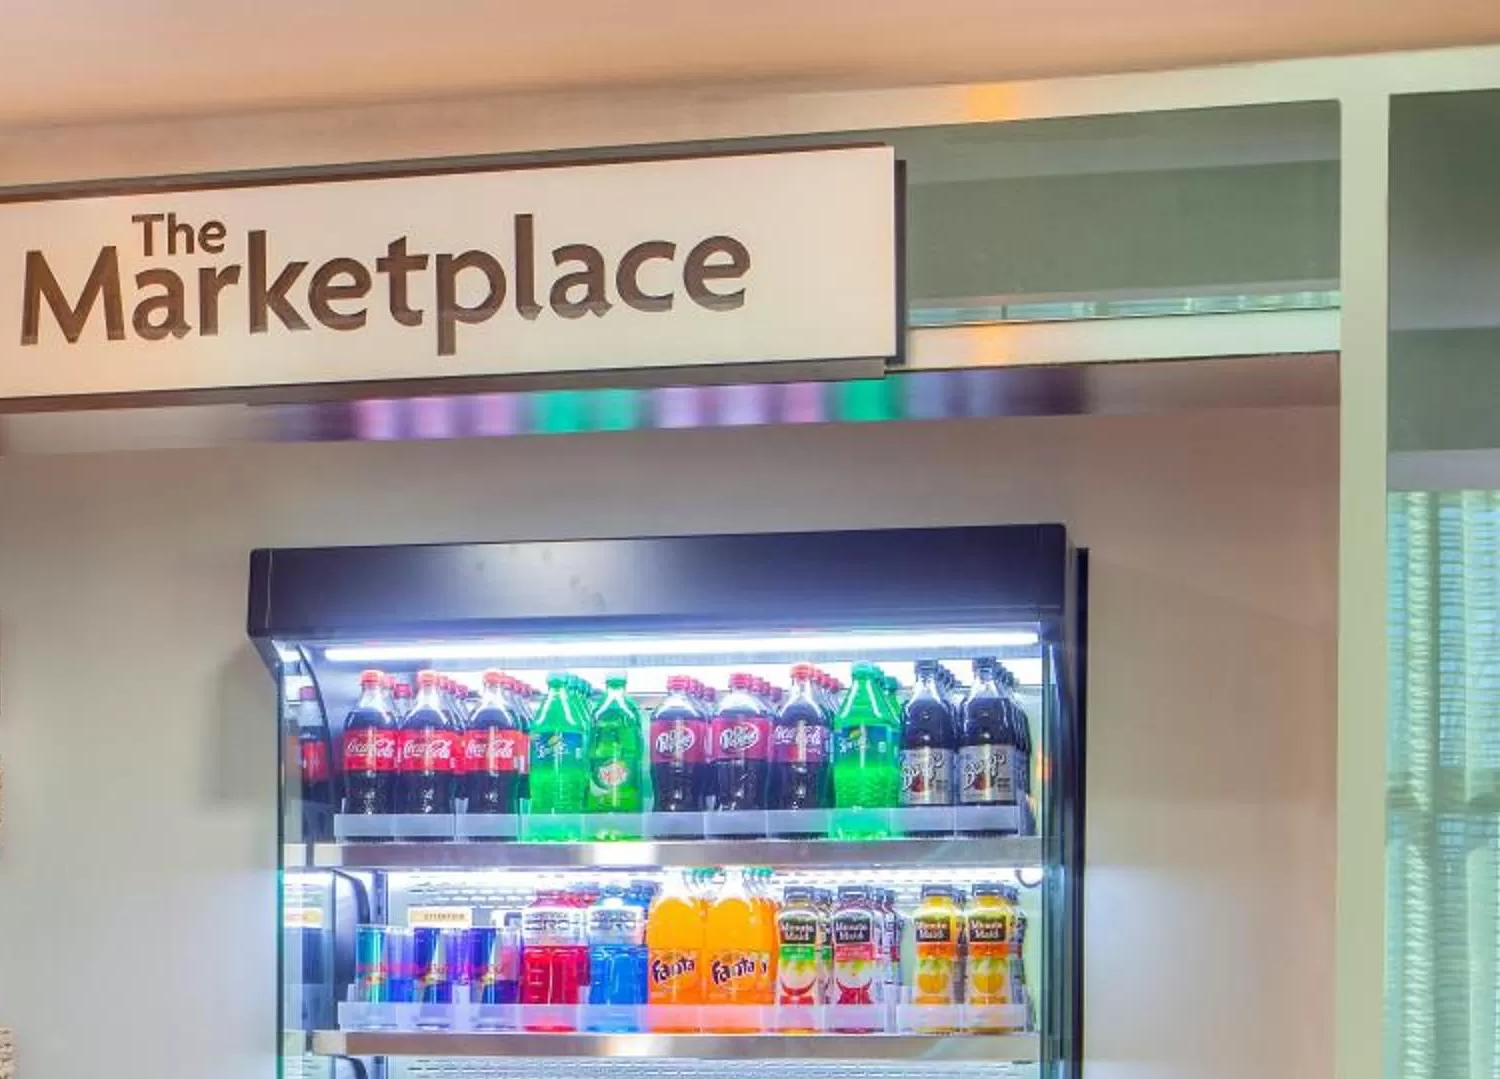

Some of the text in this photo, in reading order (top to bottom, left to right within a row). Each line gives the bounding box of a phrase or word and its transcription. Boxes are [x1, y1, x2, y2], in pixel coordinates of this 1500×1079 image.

[131, 212, 227, 256] The
[20, 213, 752, 356] Marketplace
[403, 739, 452, 759] Coca-Cola
